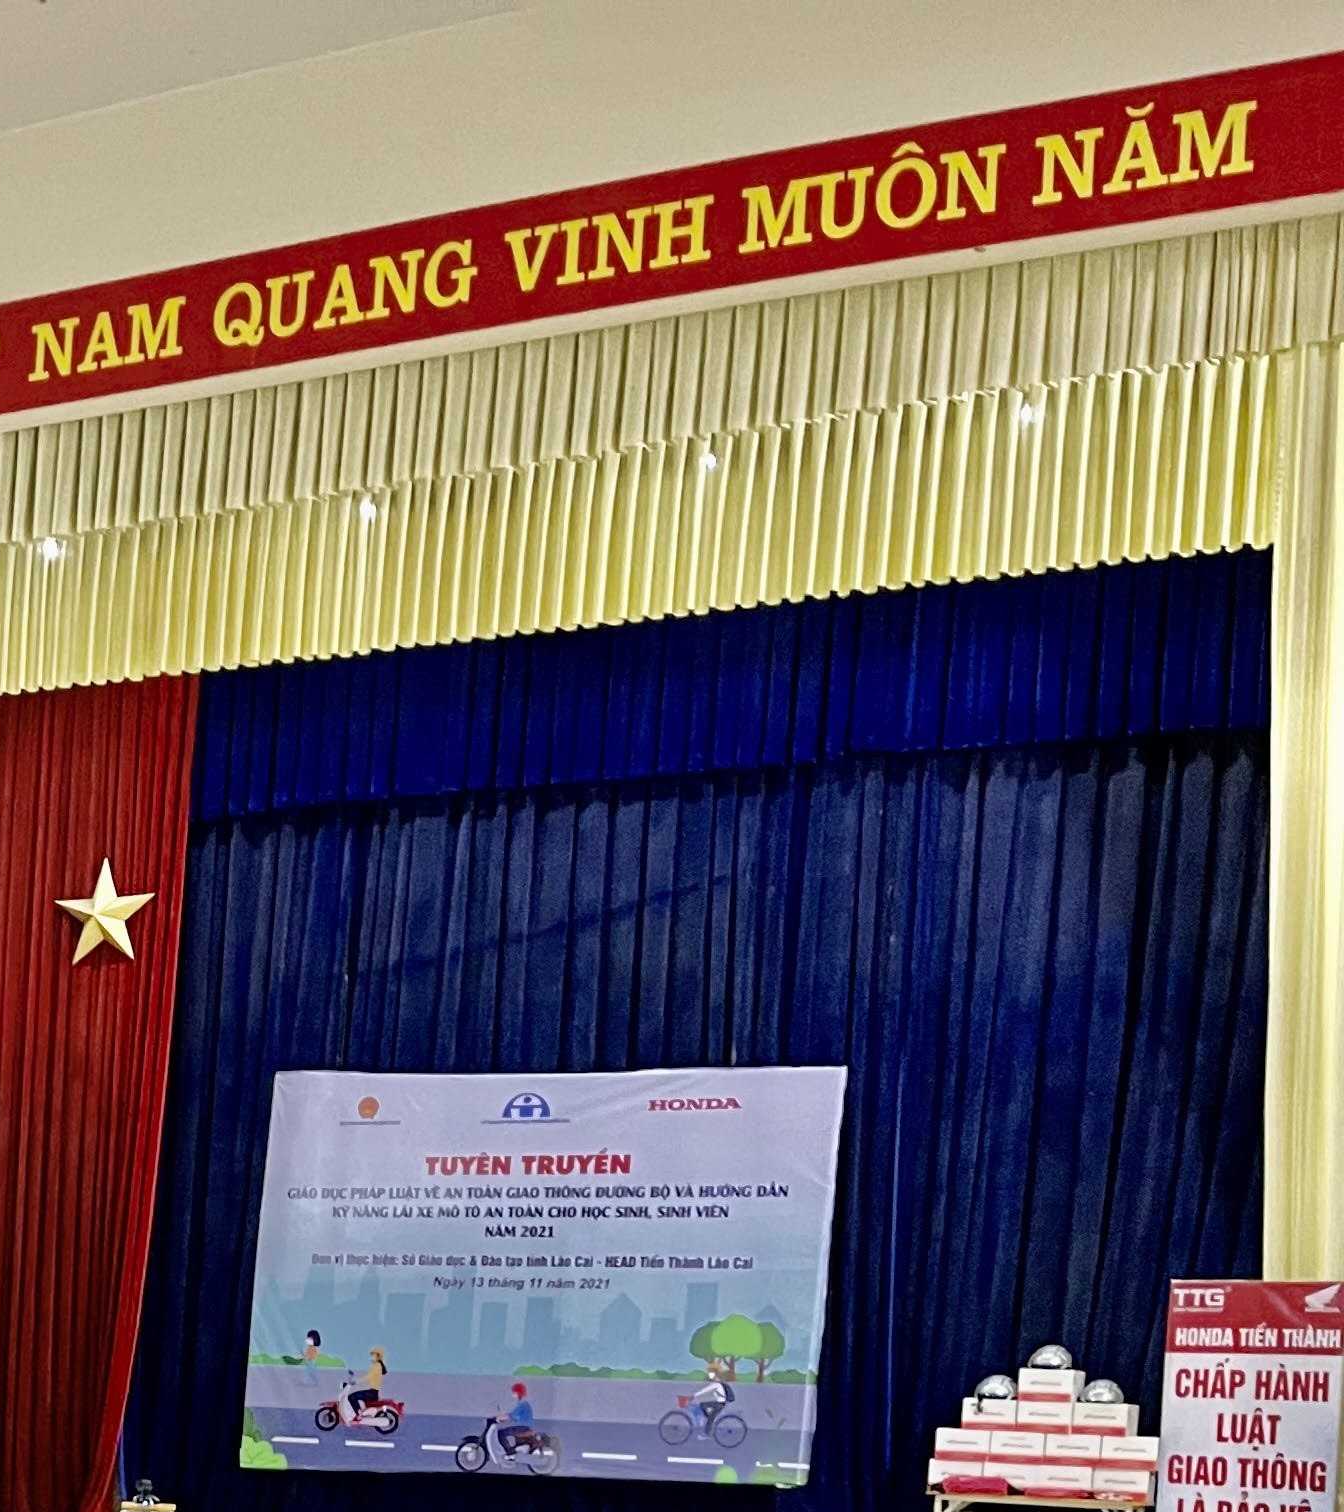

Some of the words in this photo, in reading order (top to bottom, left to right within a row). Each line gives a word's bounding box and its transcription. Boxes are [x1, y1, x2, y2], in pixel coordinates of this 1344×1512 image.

[27, 295, 187, 383] NAM
[213, 238, 479, 348] QUANG
[504, 194, 715, 293] VINH
[737, 139, 1007, 254] MUÔN
[1030, 100, 1259, 208] NĂM
[648, 1097, 742, 1111] HONDA
[425, 1151, 512, 1176] TUYÊN
[443, 1186, 463, 1199] AN
[506, 1186, 540, 1198] GIAO
[417, 1206, 434, 1218] XE
[484, 1206, 504, 1218] AN
[547, 1206, 577, 1218] CHO
[581, 1206, 612, 1220] HỌC
[657, 1206, 691, 1218] SINH
[520, 1225, 555, 1238] 2021
[471, 1277, 485, 1288] 13
[579, 1278, 611, 1289] 2021
[1173, 1287, 1225, 1306] TTG
[1175, 1327, 1234, 1347] HONDA
[1239, 1322, 1278, 1348] TIẾN
[1282, 1324, 1341, 1348] THÀNH
[1175, 1357, 1245, 1399] CHẤP
[1255, 1363, 1330, 1402] HÀNH
[1216, 1407, 1282, 1452] LUẬT
[1167, 1454, 1228, 1487] GIAO
[1237, 1453, 1327, 1493] THÔNG
